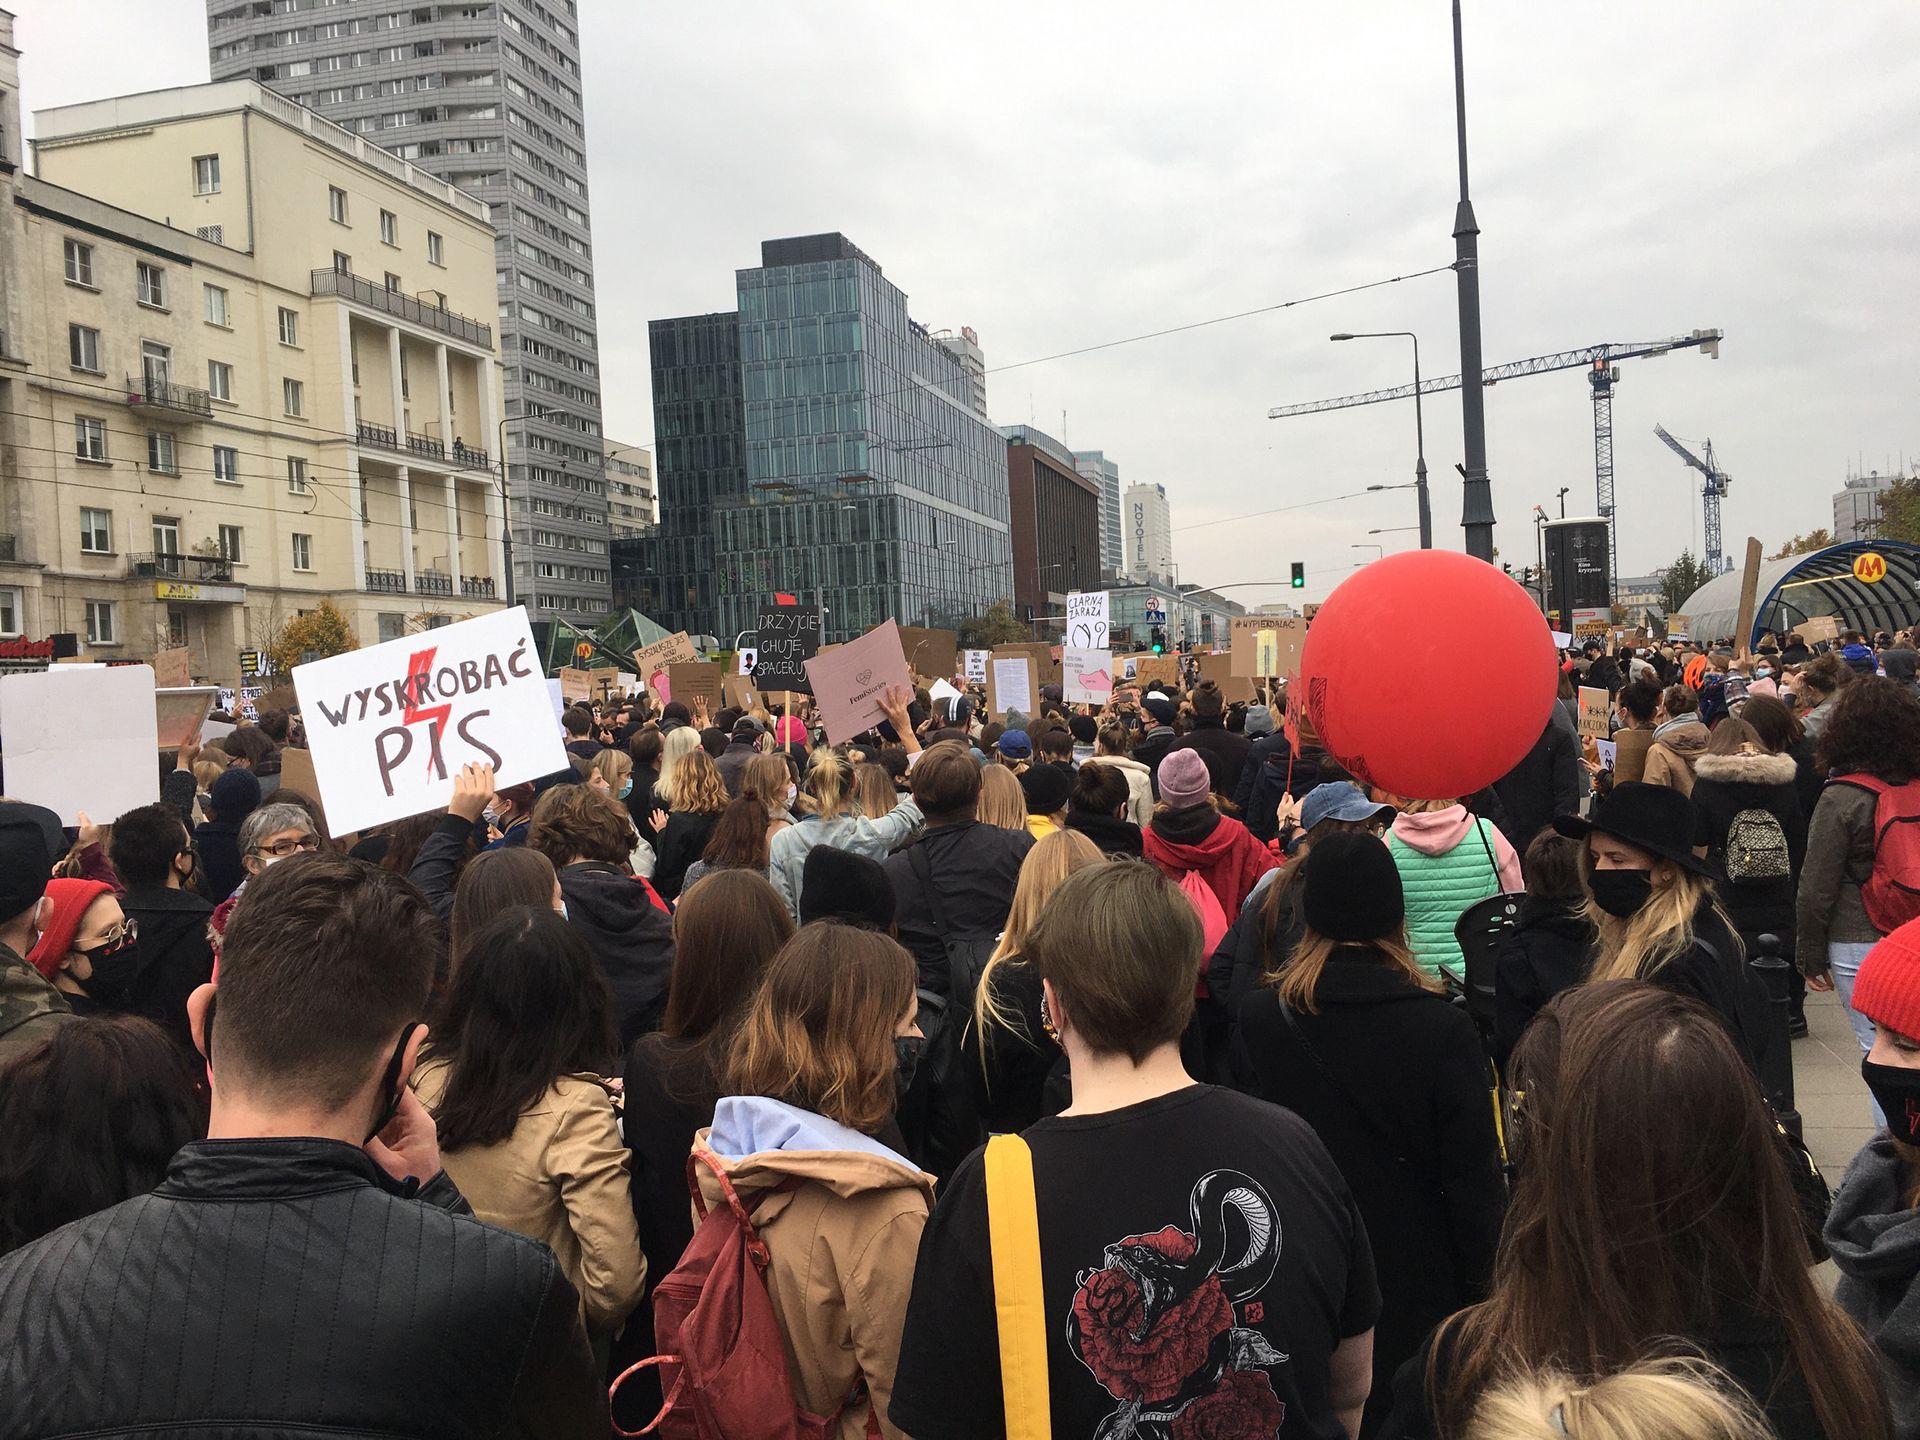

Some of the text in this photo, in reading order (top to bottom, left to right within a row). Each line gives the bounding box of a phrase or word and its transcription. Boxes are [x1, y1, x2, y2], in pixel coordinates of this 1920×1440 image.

[1135, 502, 1144, 560] NOVOTEL
[1068, 596, 1102, 609] CZARNA
[1069, 607, 1100, 620] ZARAZA
[758, 611, 818, 638] DRŻYJCIE
[317, 638, 532, 727] WYSKROBAĆ
[375, 709, 502, 796] PIS
